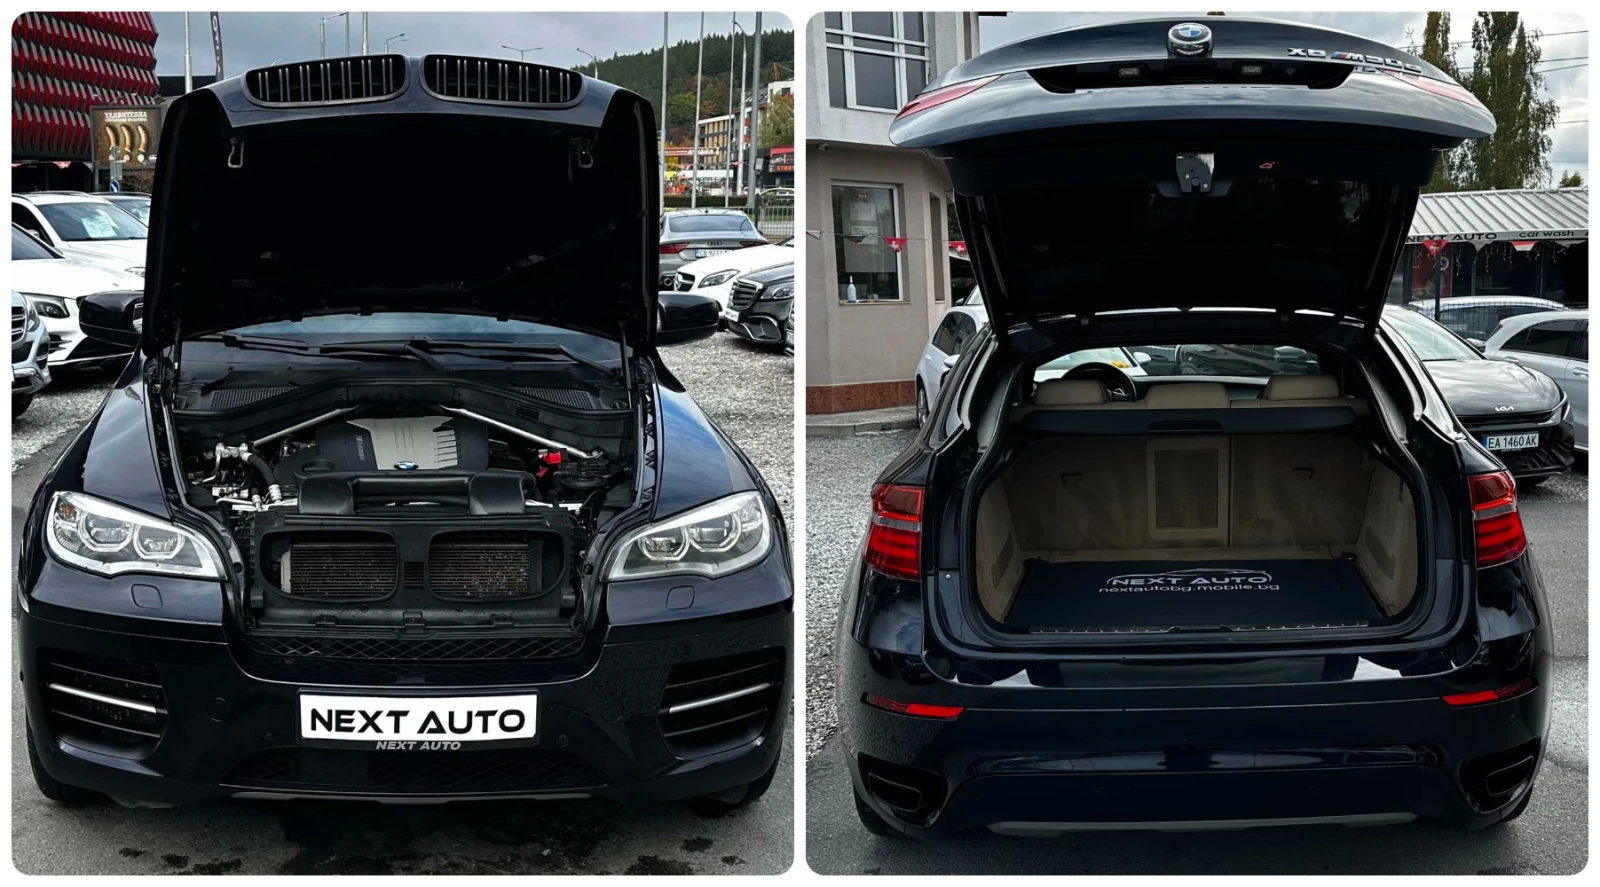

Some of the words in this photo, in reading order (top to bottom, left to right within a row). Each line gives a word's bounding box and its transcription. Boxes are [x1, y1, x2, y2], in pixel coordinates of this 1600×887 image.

[1488, 437, 1501, 448] EA
[1504, 436, 1524, 447] 1460
[1526, 434, 1537, 446] AK
[1098, 583, 1280, 593] nextautobg.mobile.bg
[310, 708, 410, 733] NEXT
[416, 709, 525, 735] AUTO
[375, 741, 417, 750] NEXT
[420, 741, 461, 750] AUTO
